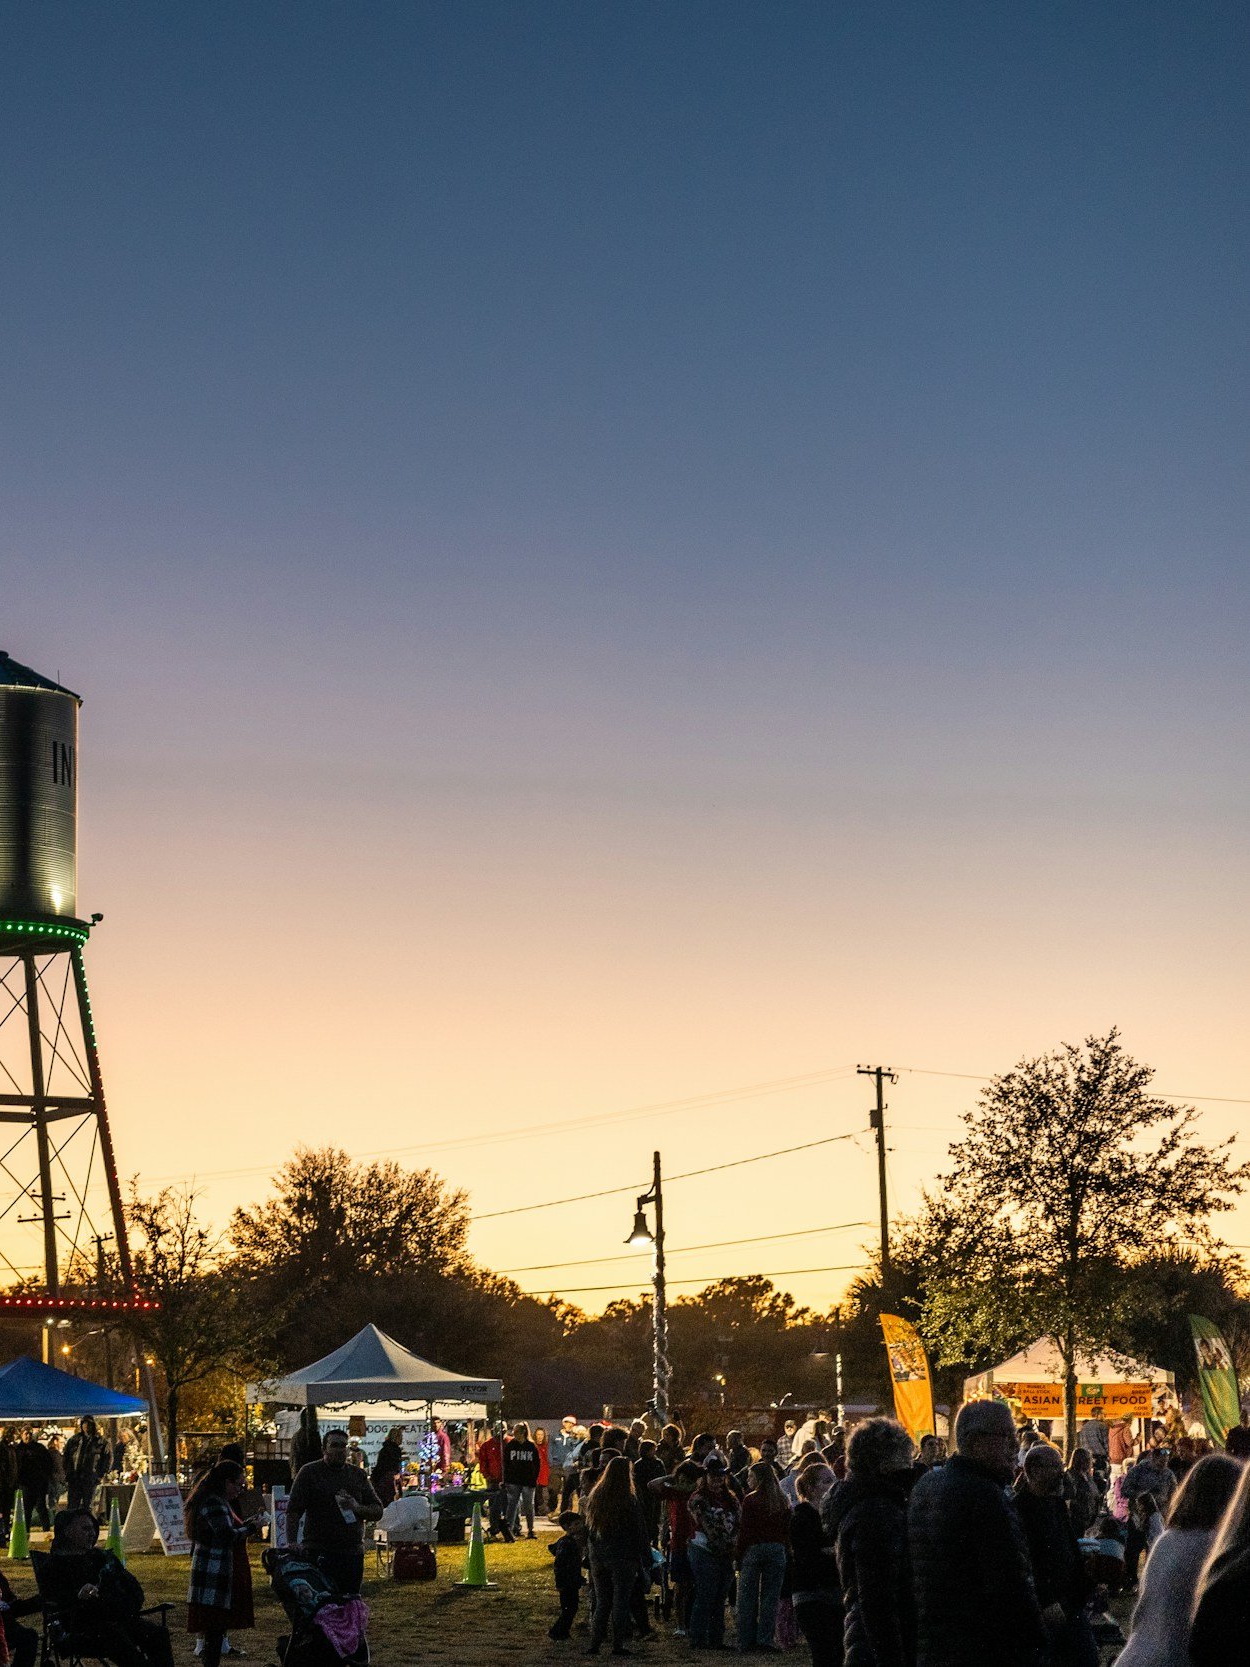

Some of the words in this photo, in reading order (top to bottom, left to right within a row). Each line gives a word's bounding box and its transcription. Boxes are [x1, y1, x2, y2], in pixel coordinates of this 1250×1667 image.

[1023, 1396, 1061, 1405] ASIAN
[1112, 1395, 1147, 1405] FOOD
[367, 1424, 389, 1434] DOG
[510, 1450, 534, 1461] PINK
